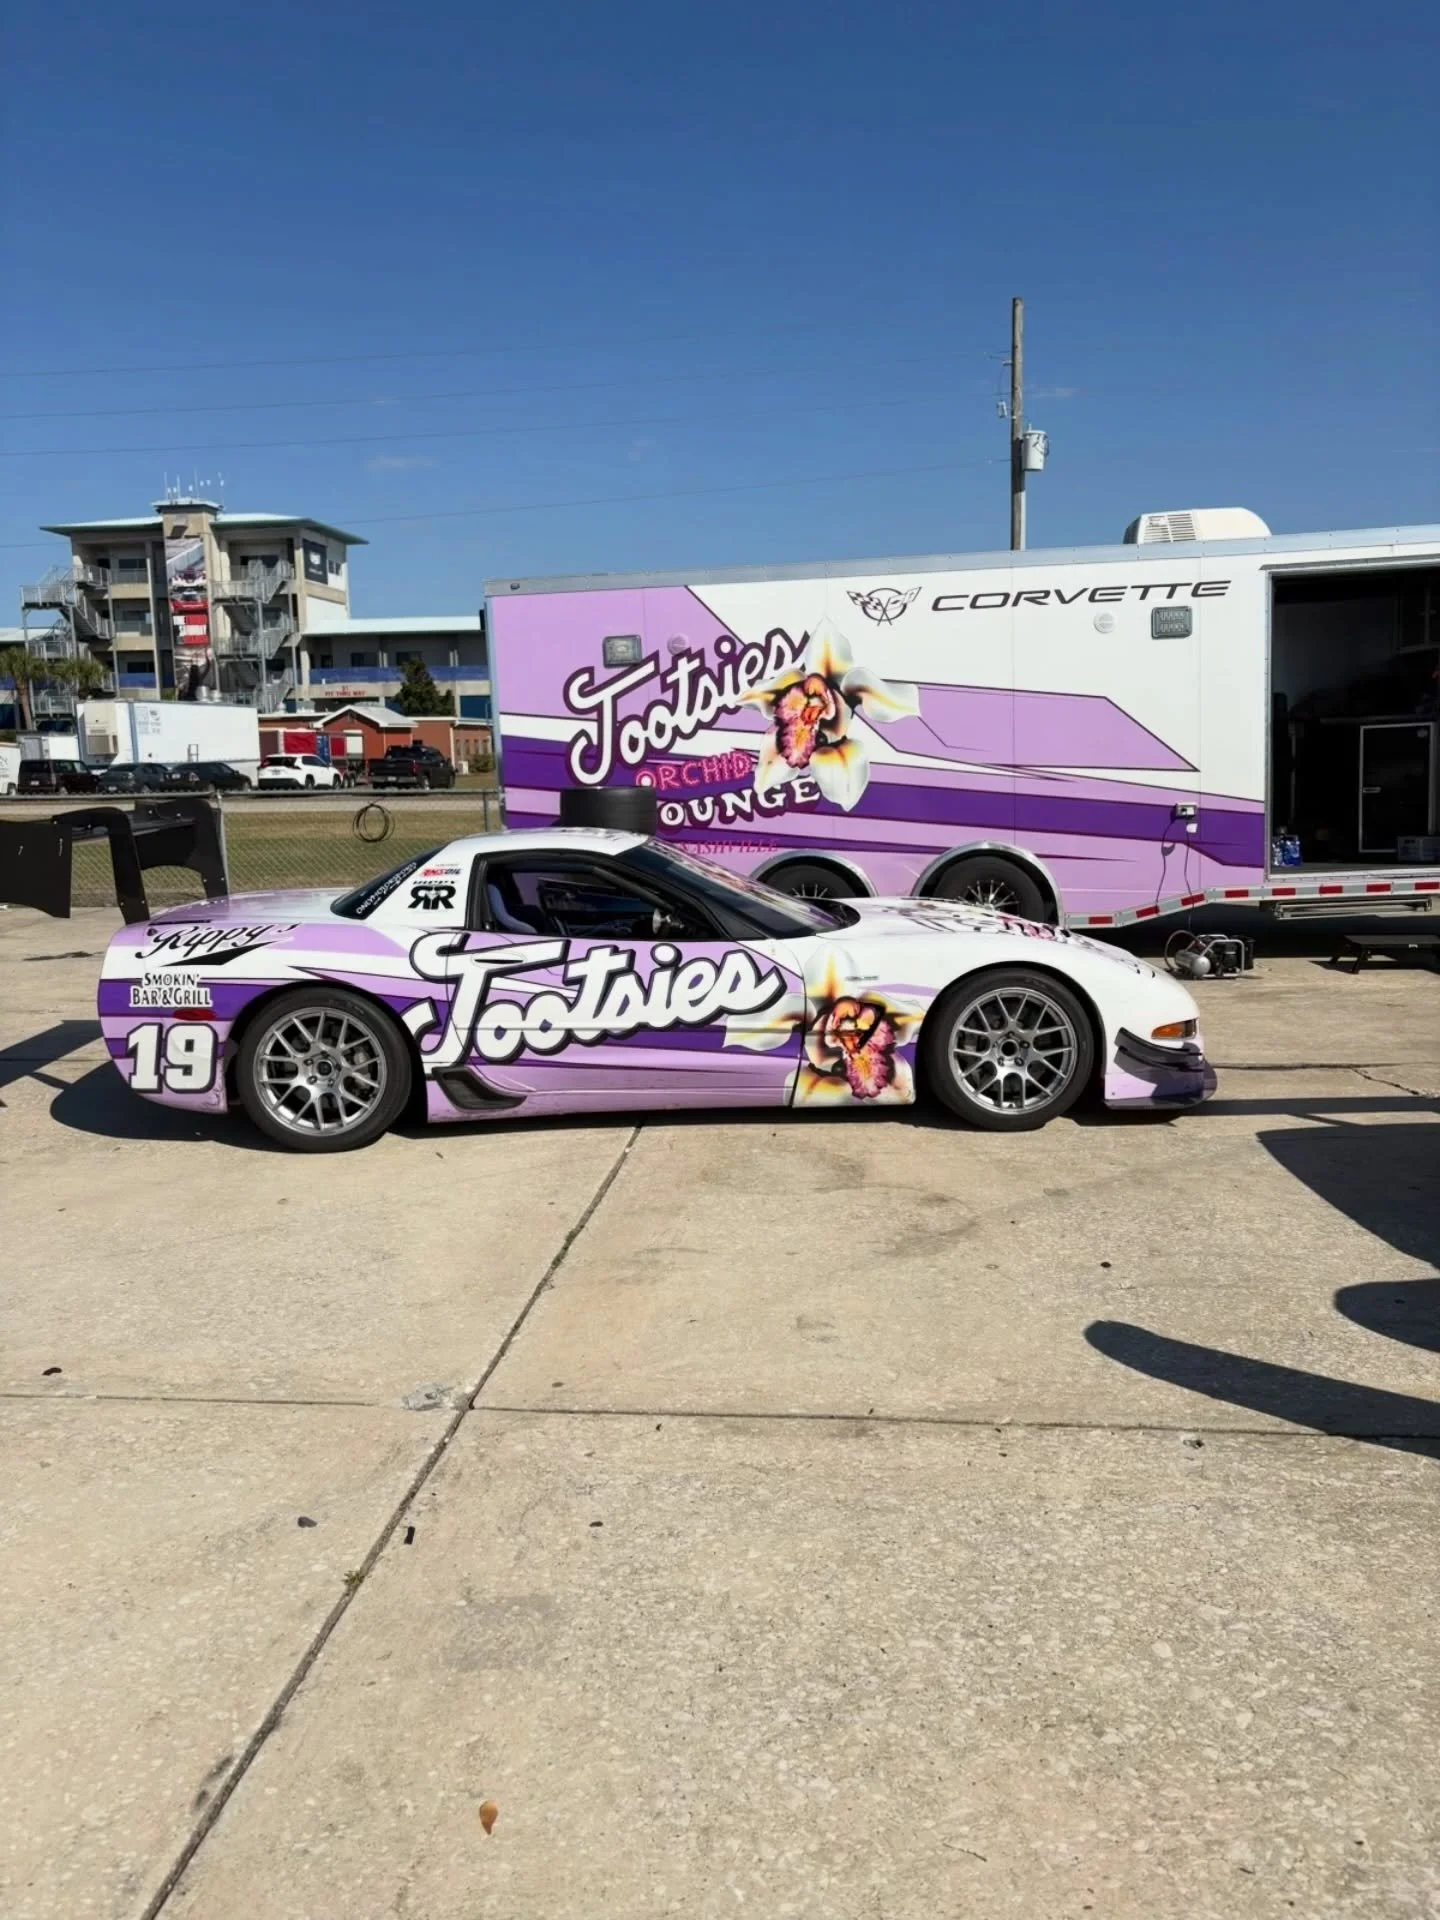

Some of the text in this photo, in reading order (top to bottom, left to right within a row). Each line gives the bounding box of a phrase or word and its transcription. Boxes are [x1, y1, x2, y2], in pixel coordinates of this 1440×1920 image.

[931, 580, 1232, 611] CORVETTE
[563, 628, 810, 786] Tootsies
[635, 750, 754, 791] ORCHID
[659, 775, 822, 828] OUNGE
[402, 931, 788, 1067] Tootsies
[126, 1022, 219, 1094] 19
